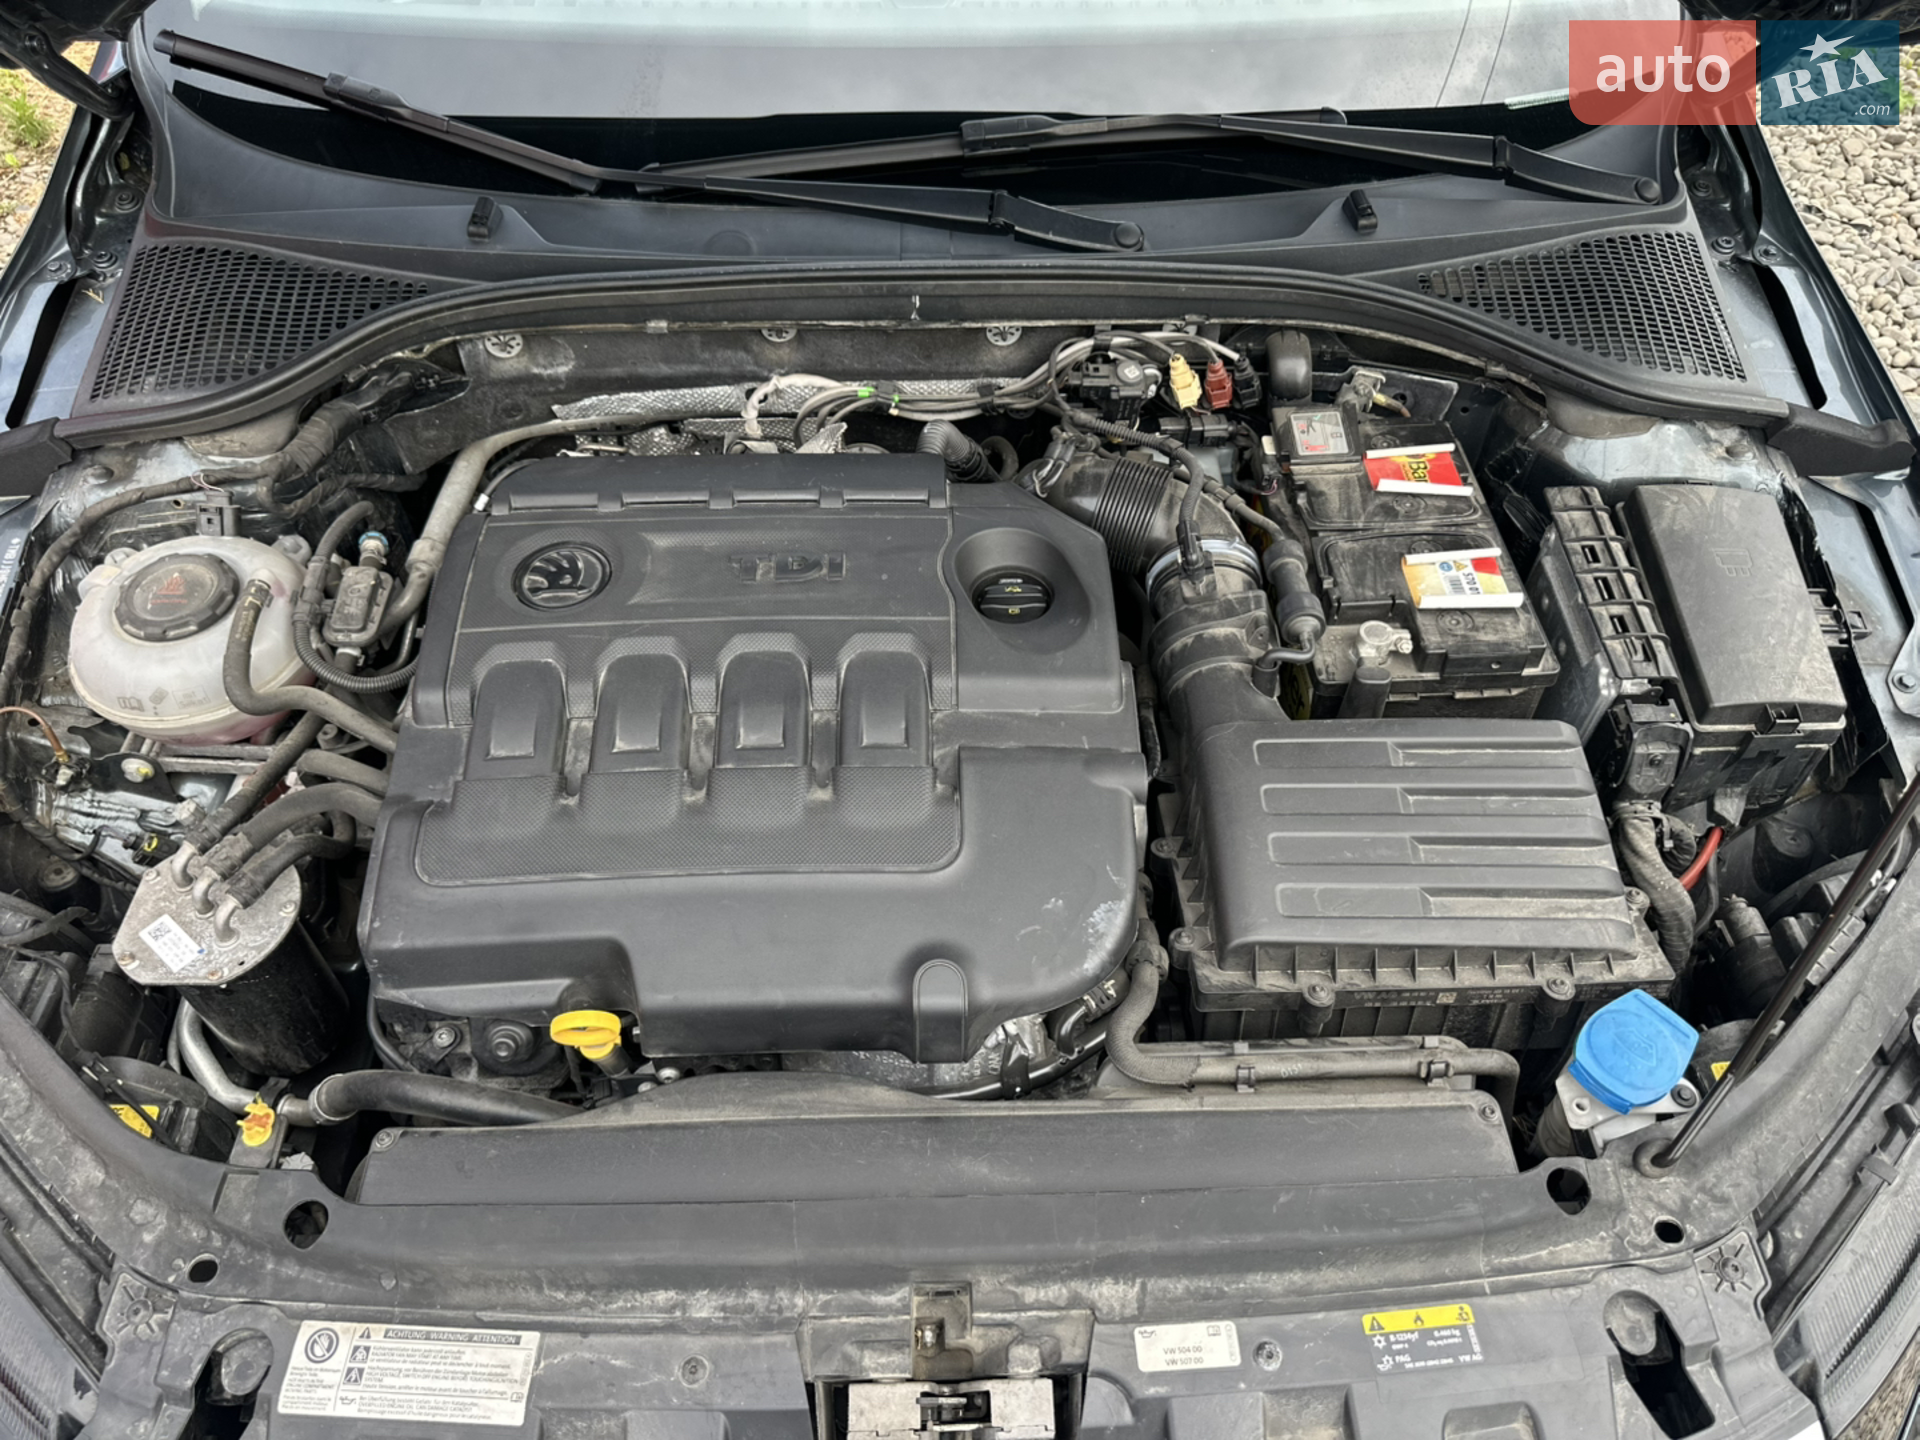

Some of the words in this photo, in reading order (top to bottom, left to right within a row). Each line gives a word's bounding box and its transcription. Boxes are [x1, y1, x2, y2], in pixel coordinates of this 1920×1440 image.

[728, 553, 848, 583] TDI
[387, 1329, 426, 1339] ACHTUNG
[430, 1331, 469, 1341] WARNING
[472, 1334, 516, 1344] ATTENTION
[1163, 1347, 1176, 1355] VW
[1192, 1345, 1203, 1353] 00
[1165, 1358, 1178, 1366] VW
